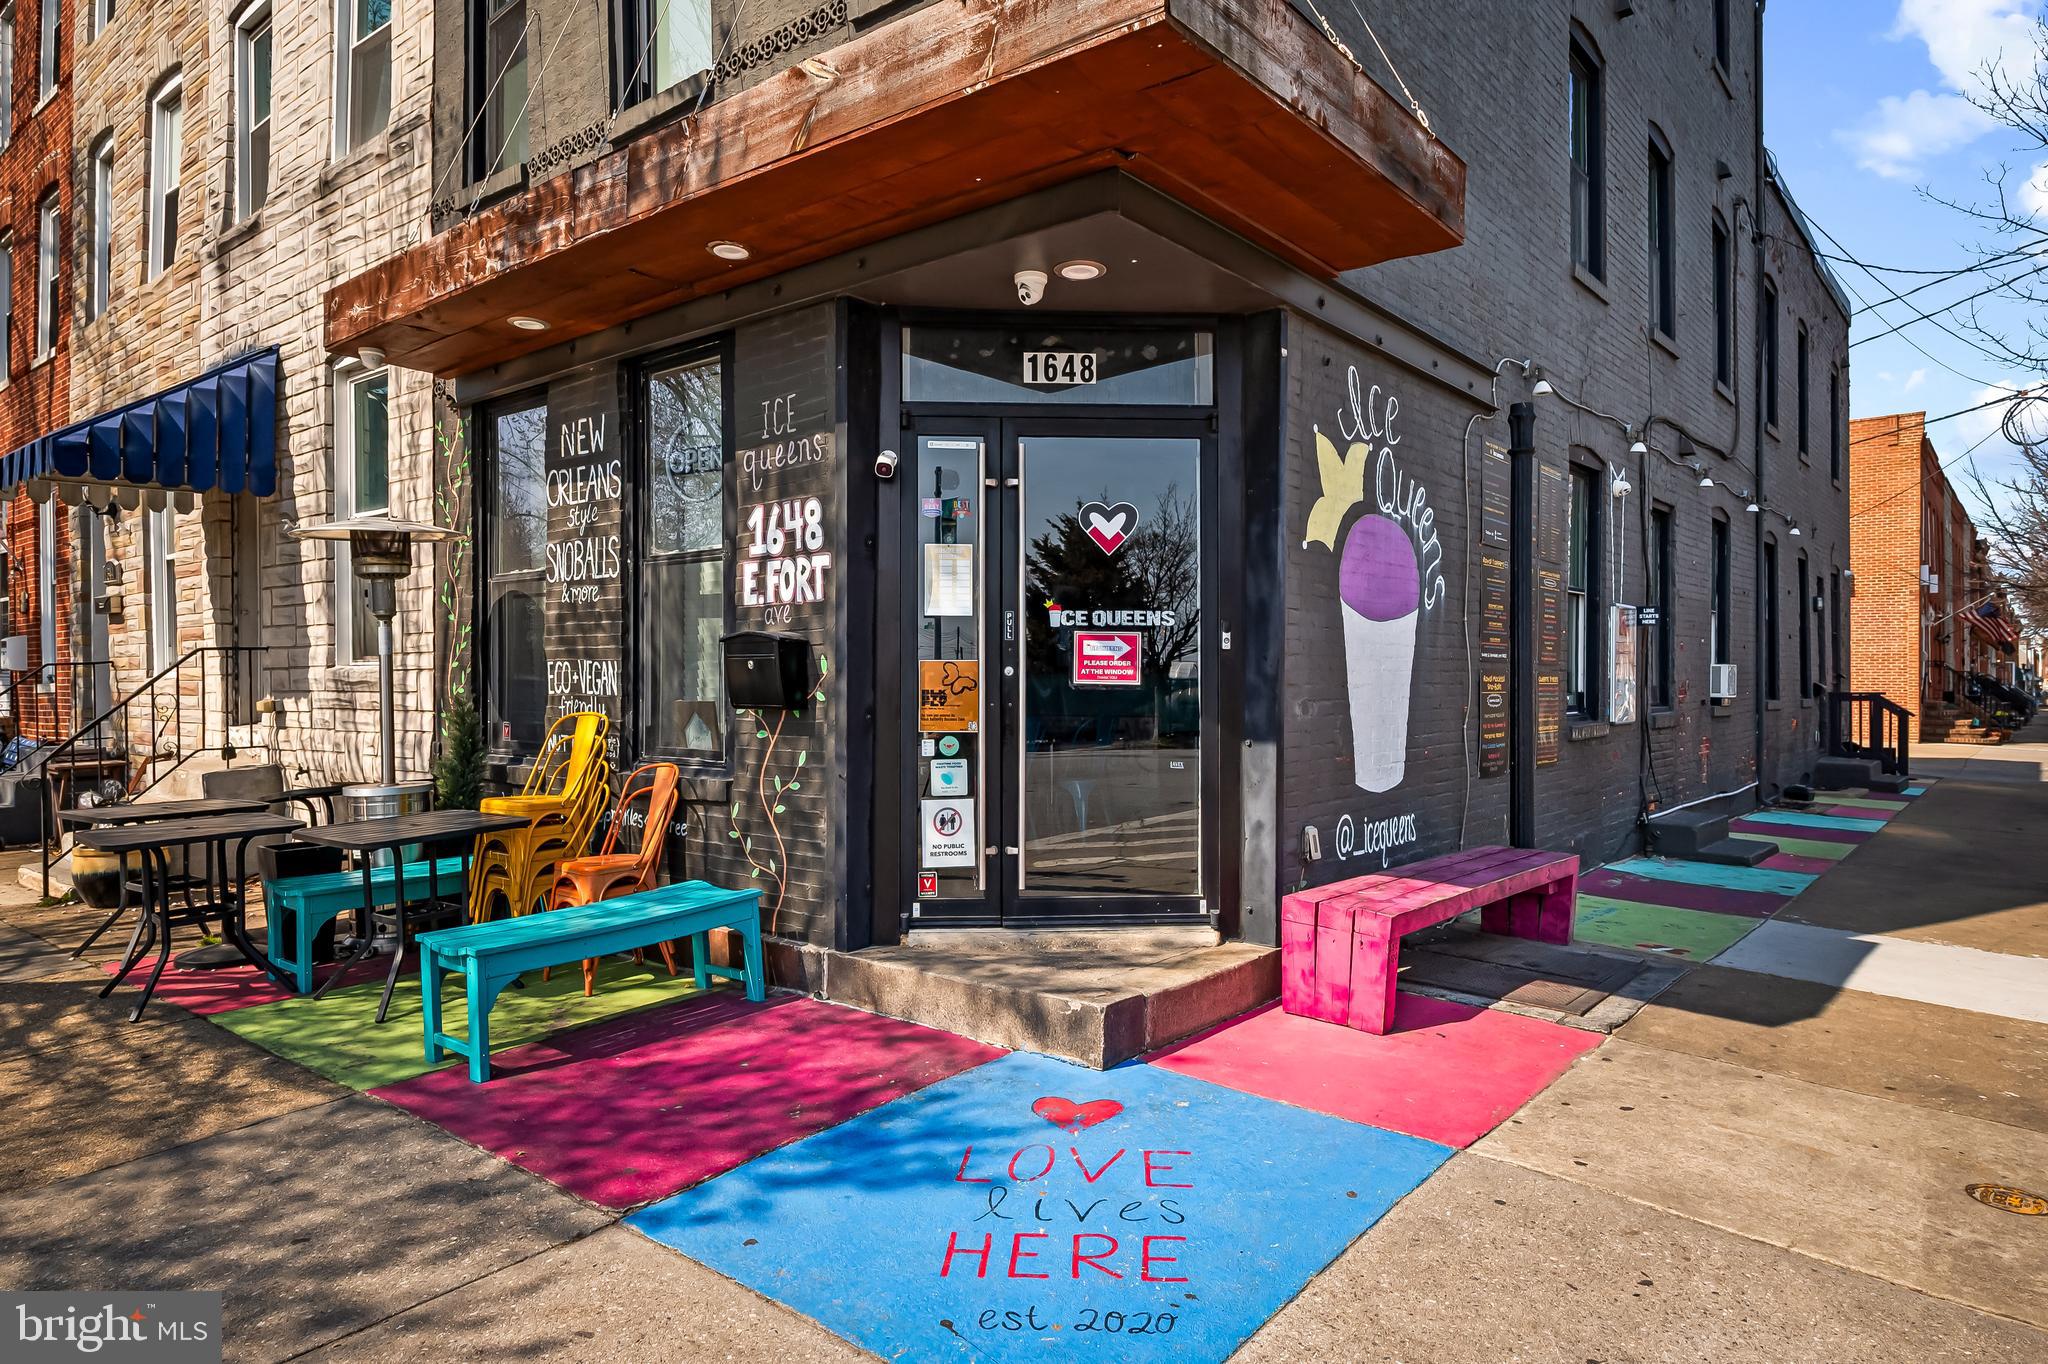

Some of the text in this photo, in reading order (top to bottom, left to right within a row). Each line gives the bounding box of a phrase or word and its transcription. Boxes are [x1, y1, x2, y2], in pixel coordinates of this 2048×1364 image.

[1027, 353, 1095, 383] 1648
[761, 393, 797, 440] ICE
[1337, 365, 1401, 445] Ice
[560, 413, 605, 458] NEW
[546, 459, 621, 507] ORLEANS
[669, 447, 723, 474] OPEN
[743, 433, 822, 491] queens
[747, 496, 824, 558] 1648
[1376, 446, 1446, 610] Queens
[546, 535, 621, 583] SNOBALLS
[764, 603, 793, 626] ave
[1091, 609, 1176, 627] QUEENS
[1336, 812, 1417, 869] @_icequeens
[955, 1144, 1194, 1188] LOVE
[973, 1186, 1185, 1224] lives
[940, 1231, 1189, 1283] HERE
[979, 1305, 1179, 1334] est 2020
